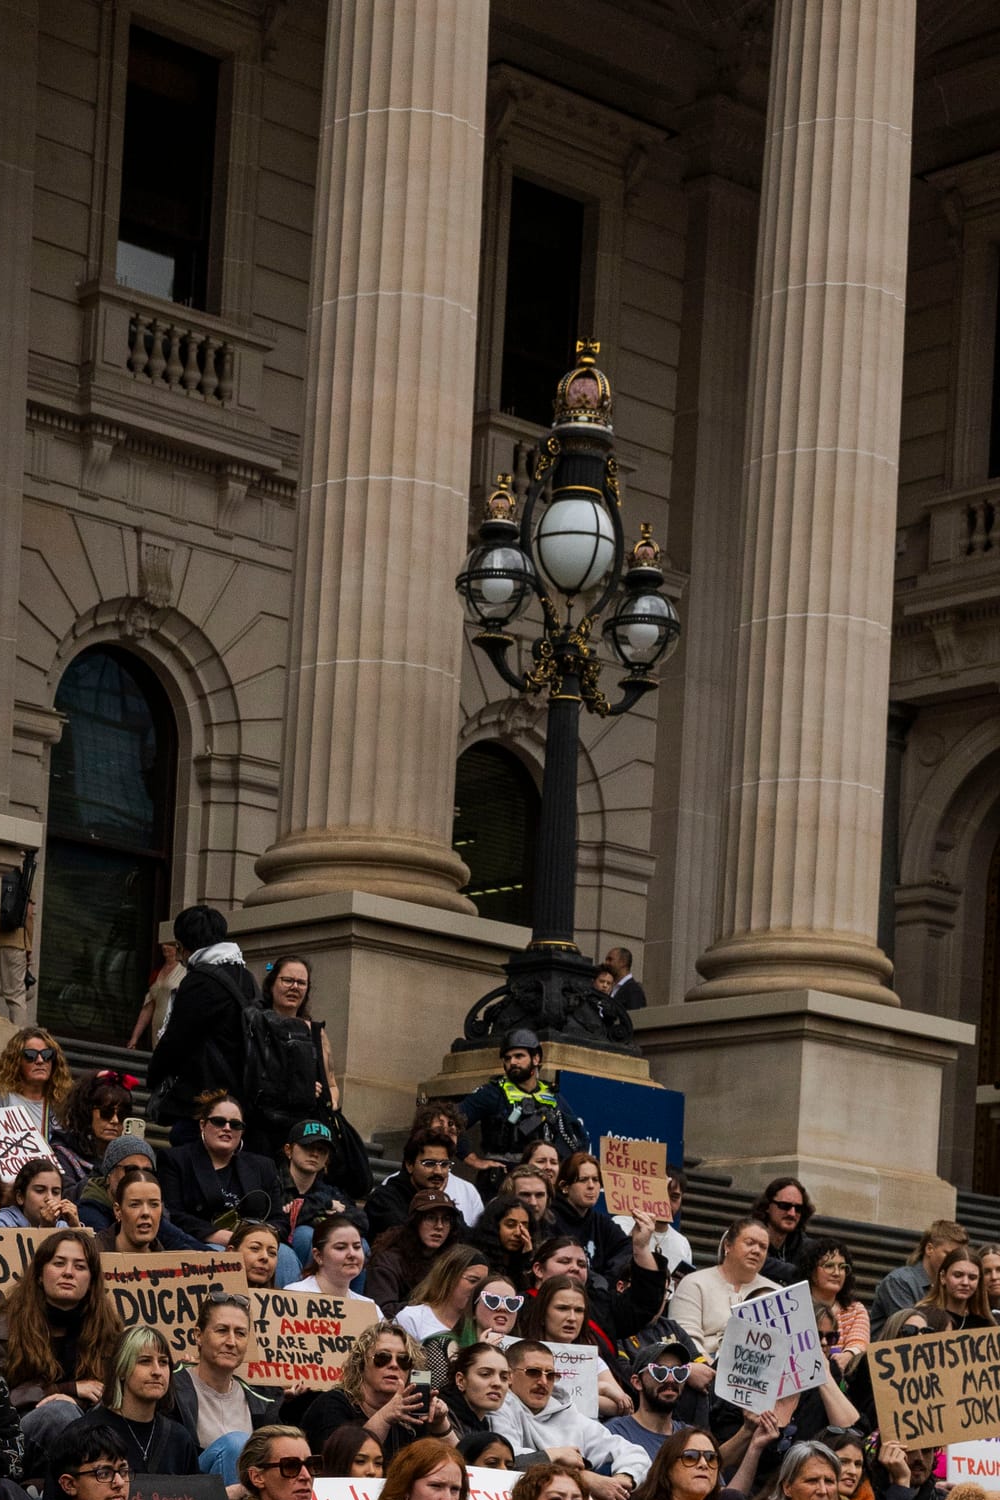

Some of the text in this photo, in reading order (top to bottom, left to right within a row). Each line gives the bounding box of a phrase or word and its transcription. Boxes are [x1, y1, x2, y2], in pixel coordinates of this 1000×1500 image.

[608, 1141, 630, 1156] WE
[606, 1152, 658, 1176] REFUSE
[607, 1172, 653, 1196] TO BE
[104, 1283, 224, 1326] DUCAT
[254, 1292, 346, 1319] YOU ARE
[280, 1318, 341, 1336] ANGRY
[276, 1335, 308, 1350] ARE
[318, 1335, 356, 1353] NOT
[264, 1348, 324, 1365] PAYING
[875, 1333, 1000, 1380] STATISTICA
[732, 1361, 759, 1375] MEAN
[734, 1389, 752, 1404] ME
[890, 1373, 944, 1405] YOUR
